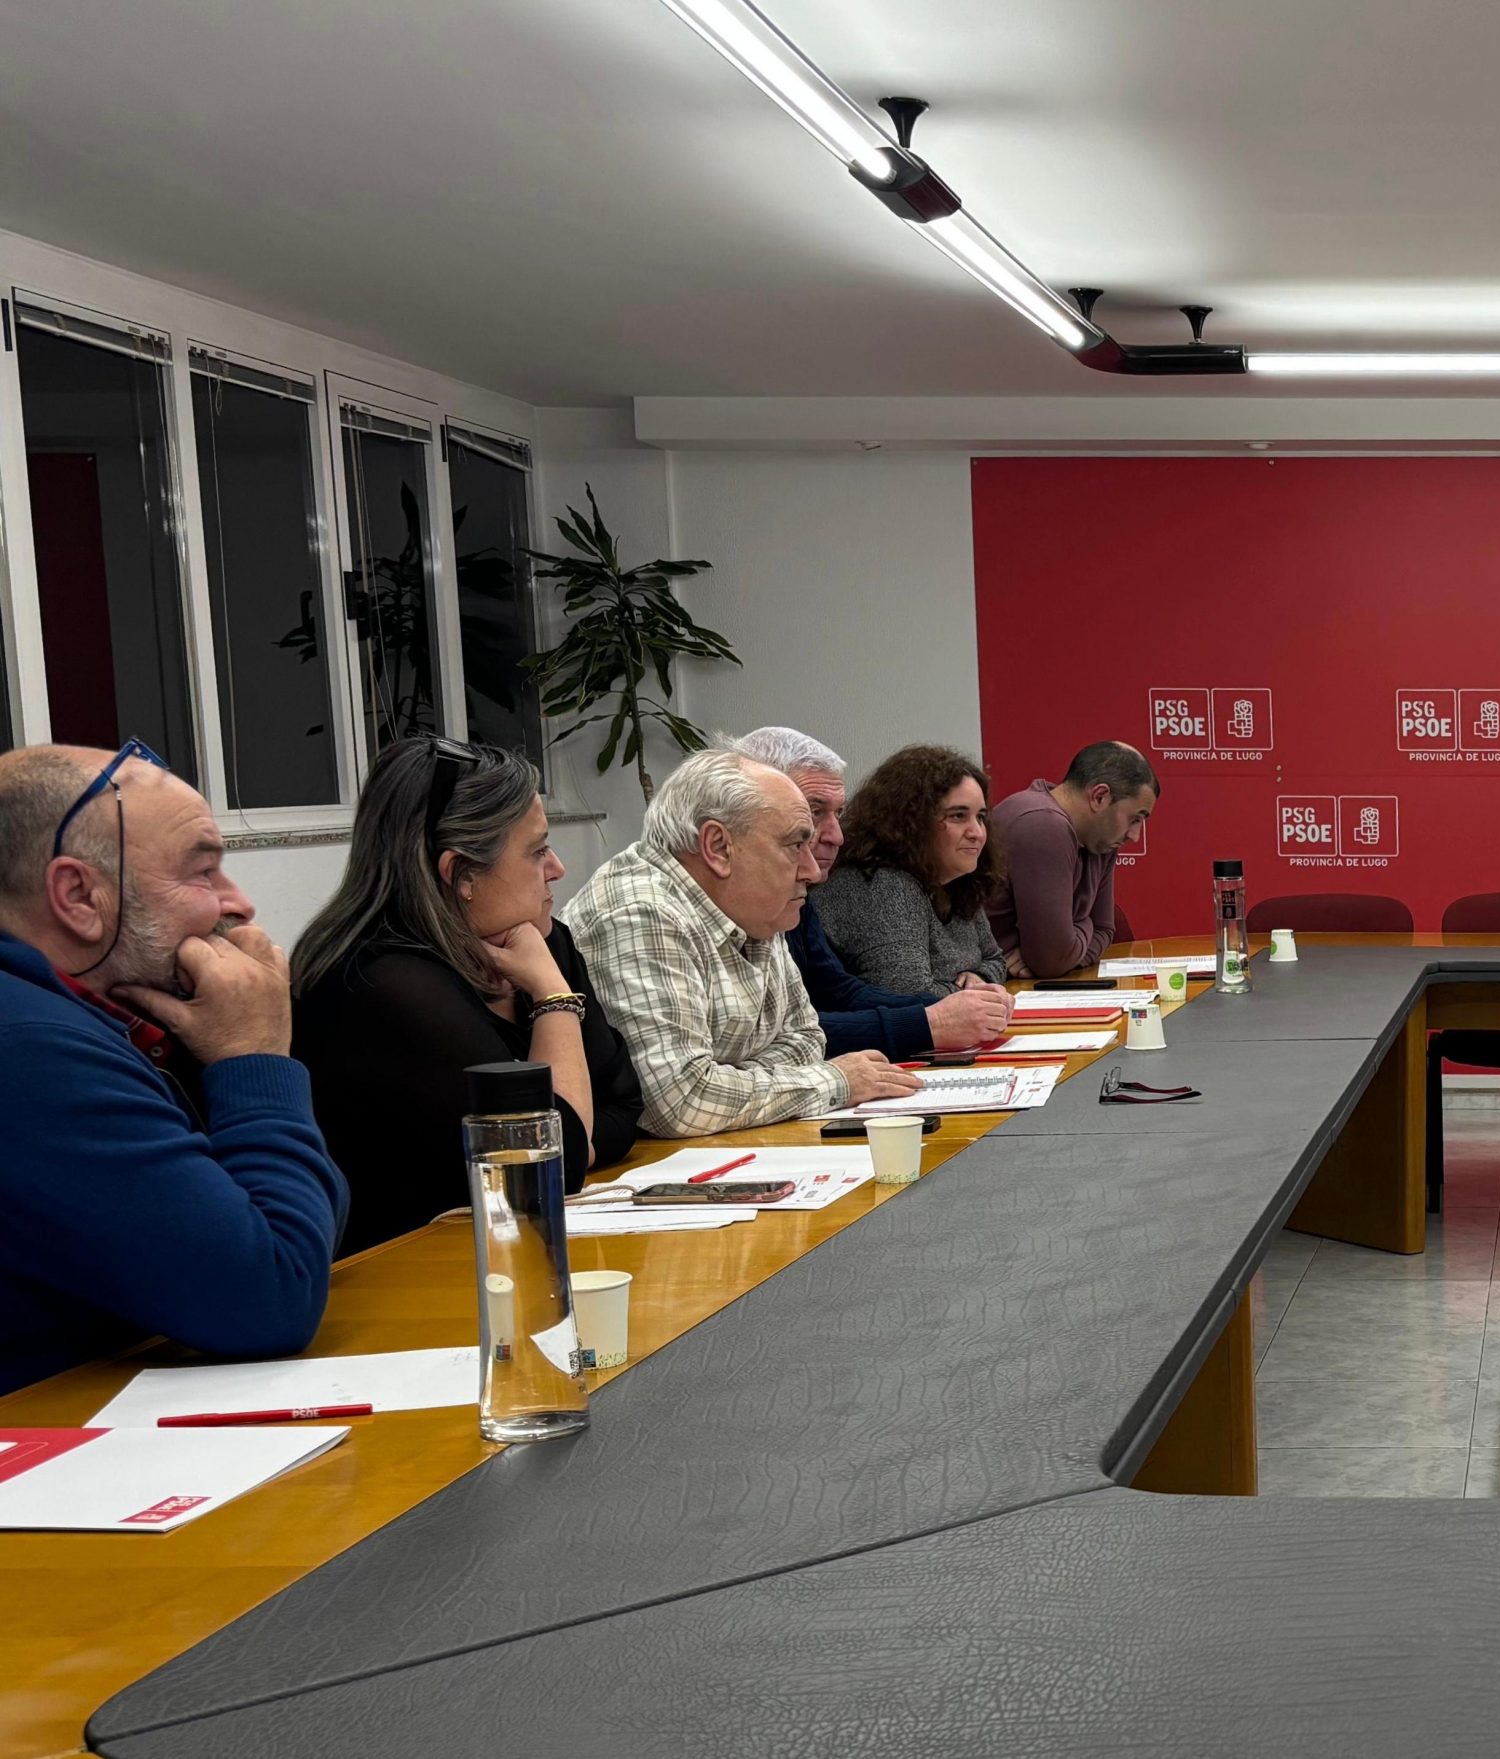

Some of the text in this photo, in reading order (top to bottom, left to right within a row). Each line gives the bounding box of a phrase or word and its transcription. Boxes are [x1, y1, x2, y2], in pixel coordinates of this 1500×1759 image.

[1156, 717, 1205, 736] PSOE
[1402, 718, 1452, 737] PSOE
[1164, 751, 1262, 761] PROVINCIA DE LUGO
[1409, 752, 1463, 762] PROVINCIA
[1466, 752, 1479, 762] DE
[1283, 824, 1332, 843] PSOE
[1115, 857, 1136, 866] UGO
[1290, 857, 1388, 867] PROVINCIA DE LUGO
[291, 1407, 321, 1419] PSOE
